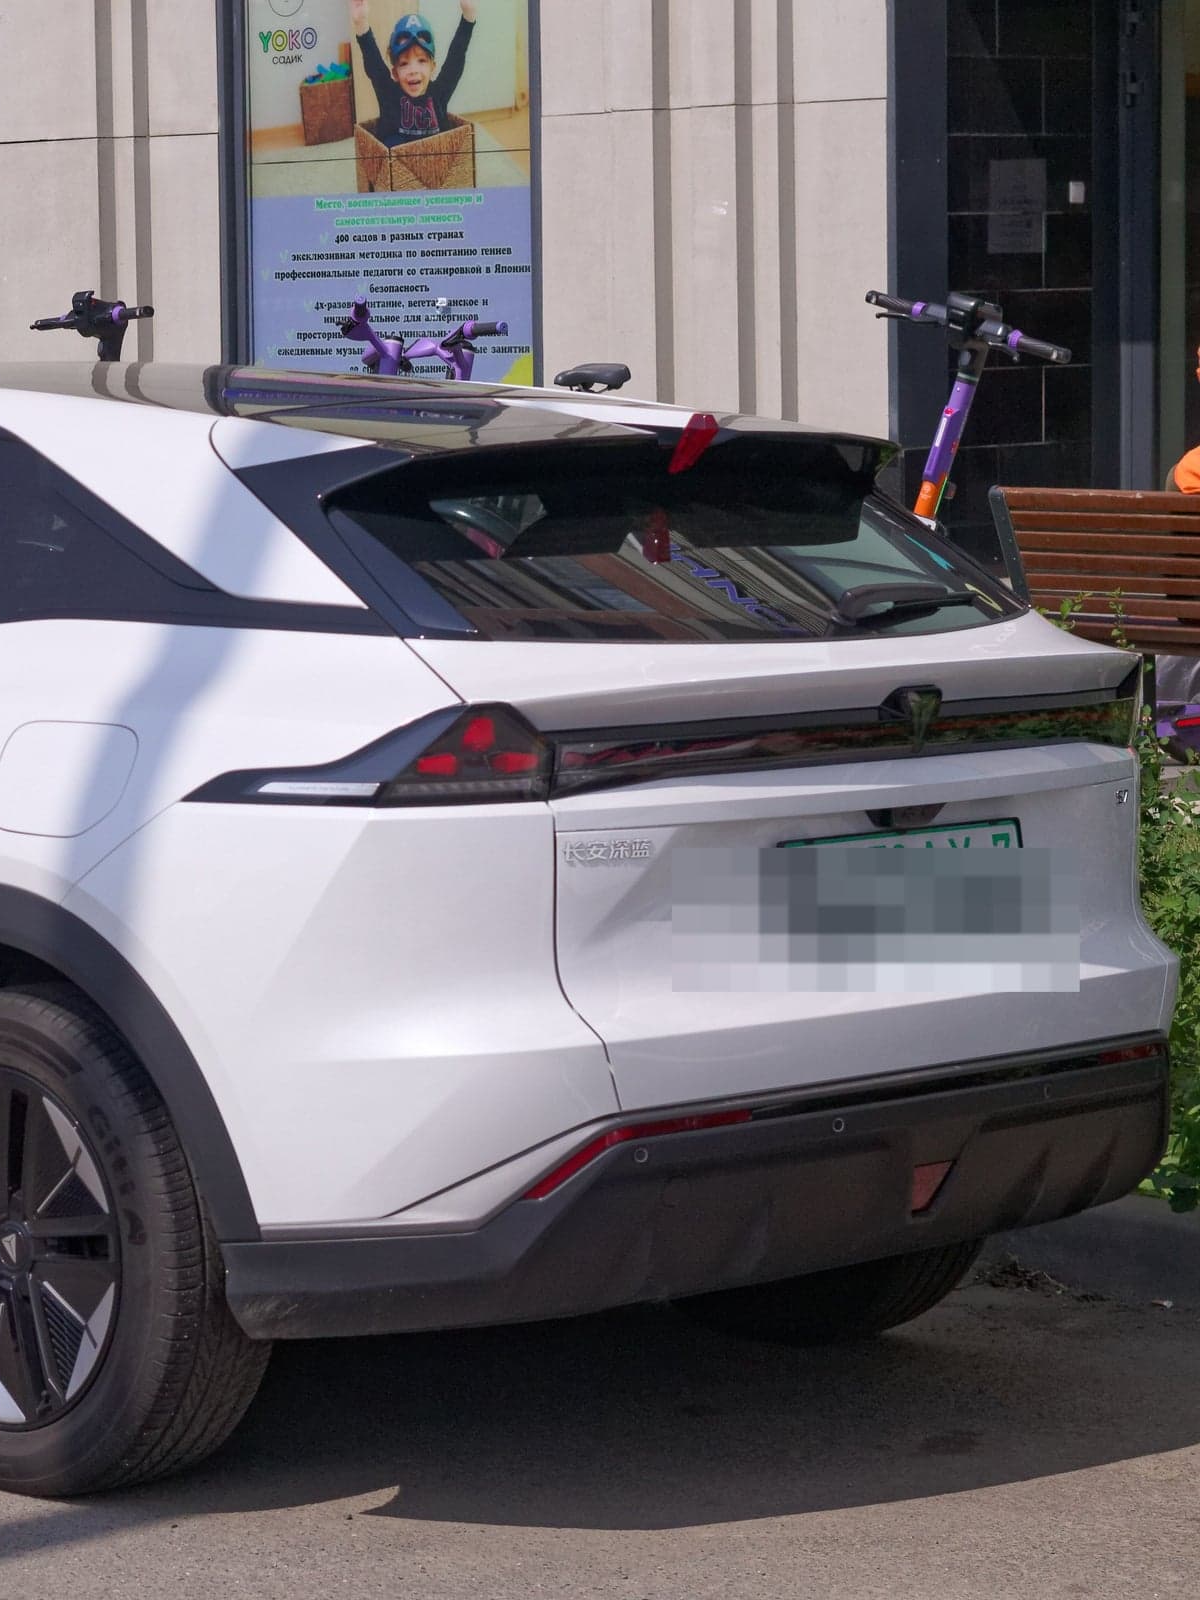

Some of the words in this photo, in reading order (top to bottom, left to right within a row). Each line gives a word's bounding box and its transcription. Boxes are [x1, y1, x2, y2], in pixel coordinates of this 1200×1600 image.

[258, 27, 318, 54] YOKO
[272, 53, 304, 65] садик
[418, 213, 463, 224] личность
[334, 233, 350, 245] 400
[352, 233, 378, 243] садов
[381, 232, 387, 242] в
[389, 231, 424, 243] разных
[427, 230, 465, 242] странах
[291, 251, 356, 262] эксклюзивная
[358, 249, 403, 260] методика
[405, 249, 417, 259] по
[420, 247, 478, 259] воспитанию
[480, 246, 512, 257] гениев
[274, 269, 361, 282] профессиональные
[362, 267, 404, 279] педагоги
[406, 267, 417, 276] со
[419, 264, 483, 278] стажировкой
[485, 265, 491, 275] в
[494, 263, 531, 275] Японии
[369, 282, 430, 294] безопасность
[481, 298, 489, 308] и
[403, 313, 422, 324] для
[424, 311, 480, 325] аллергиков
[277, 346, 334, 356] ежедневные
[490, 344, 531, 355] занятия
[563, 839, 650, 862] 长安深蓝
